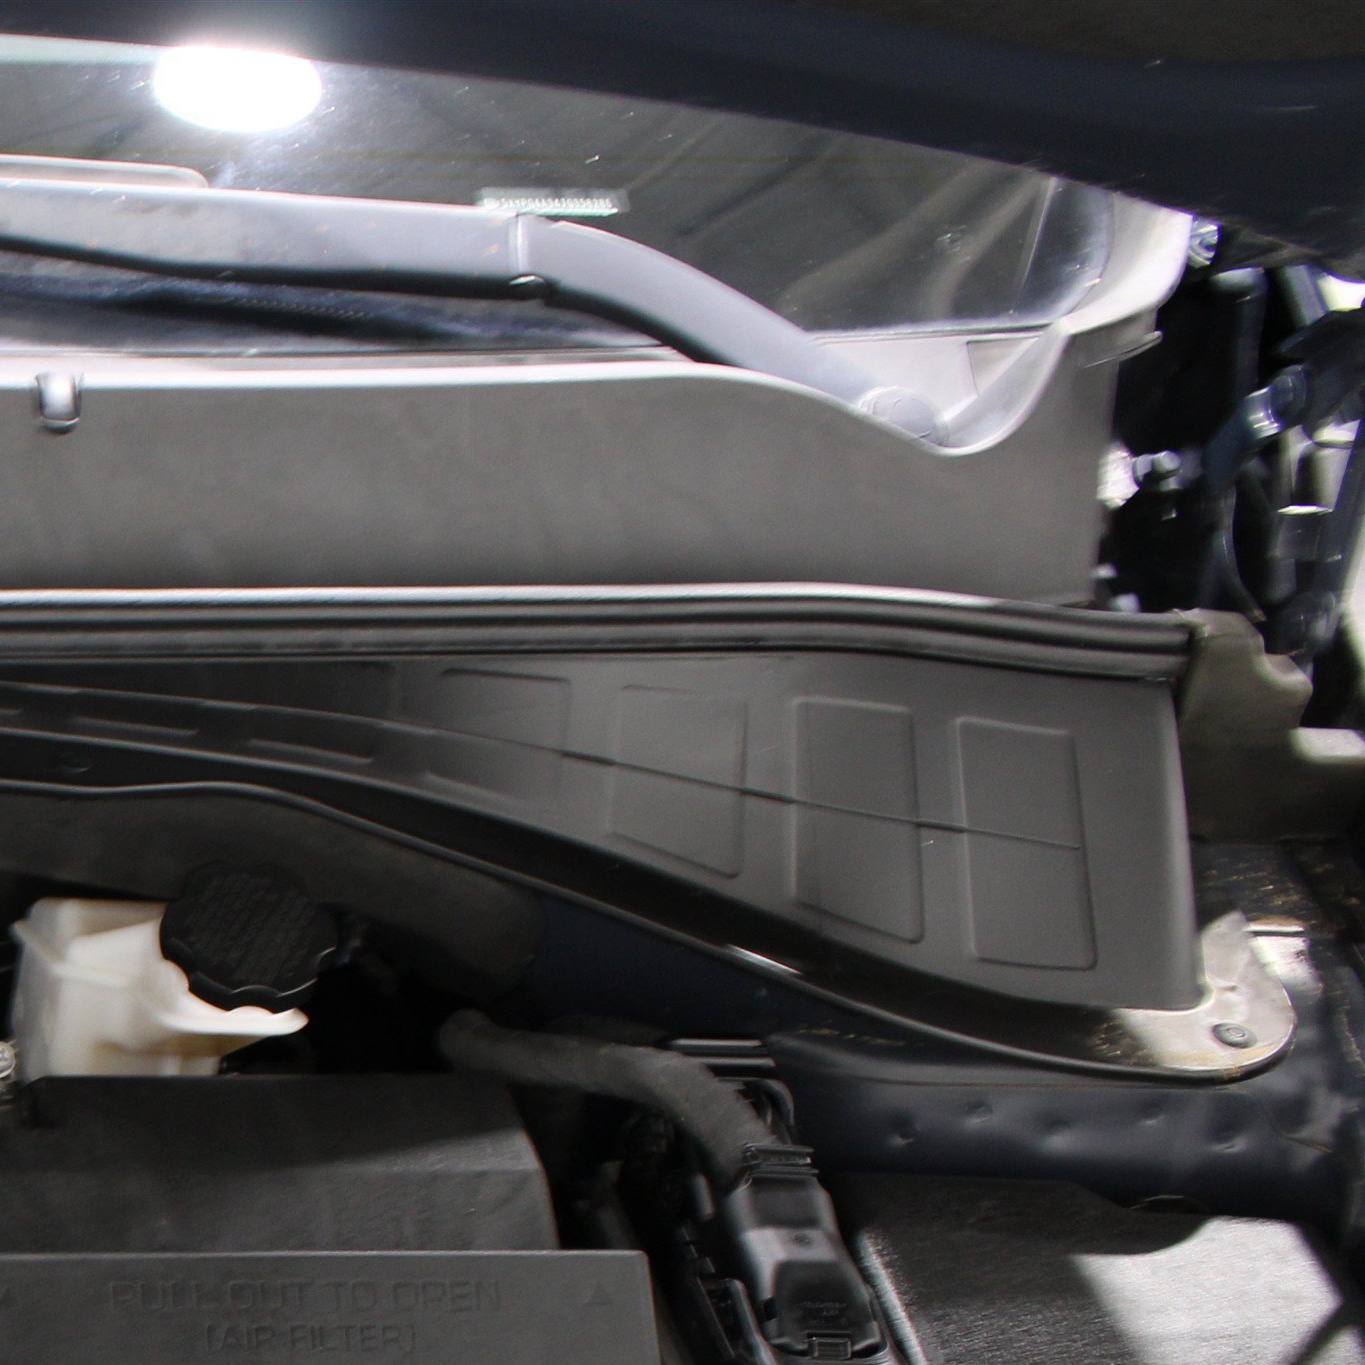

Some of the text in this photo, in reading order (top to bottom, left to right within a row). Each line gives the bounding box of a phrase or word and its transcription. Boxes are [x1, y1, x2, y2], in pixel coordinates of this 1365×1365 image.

[110, 1280, 501, 1312] PULL OUT TO OPEN
